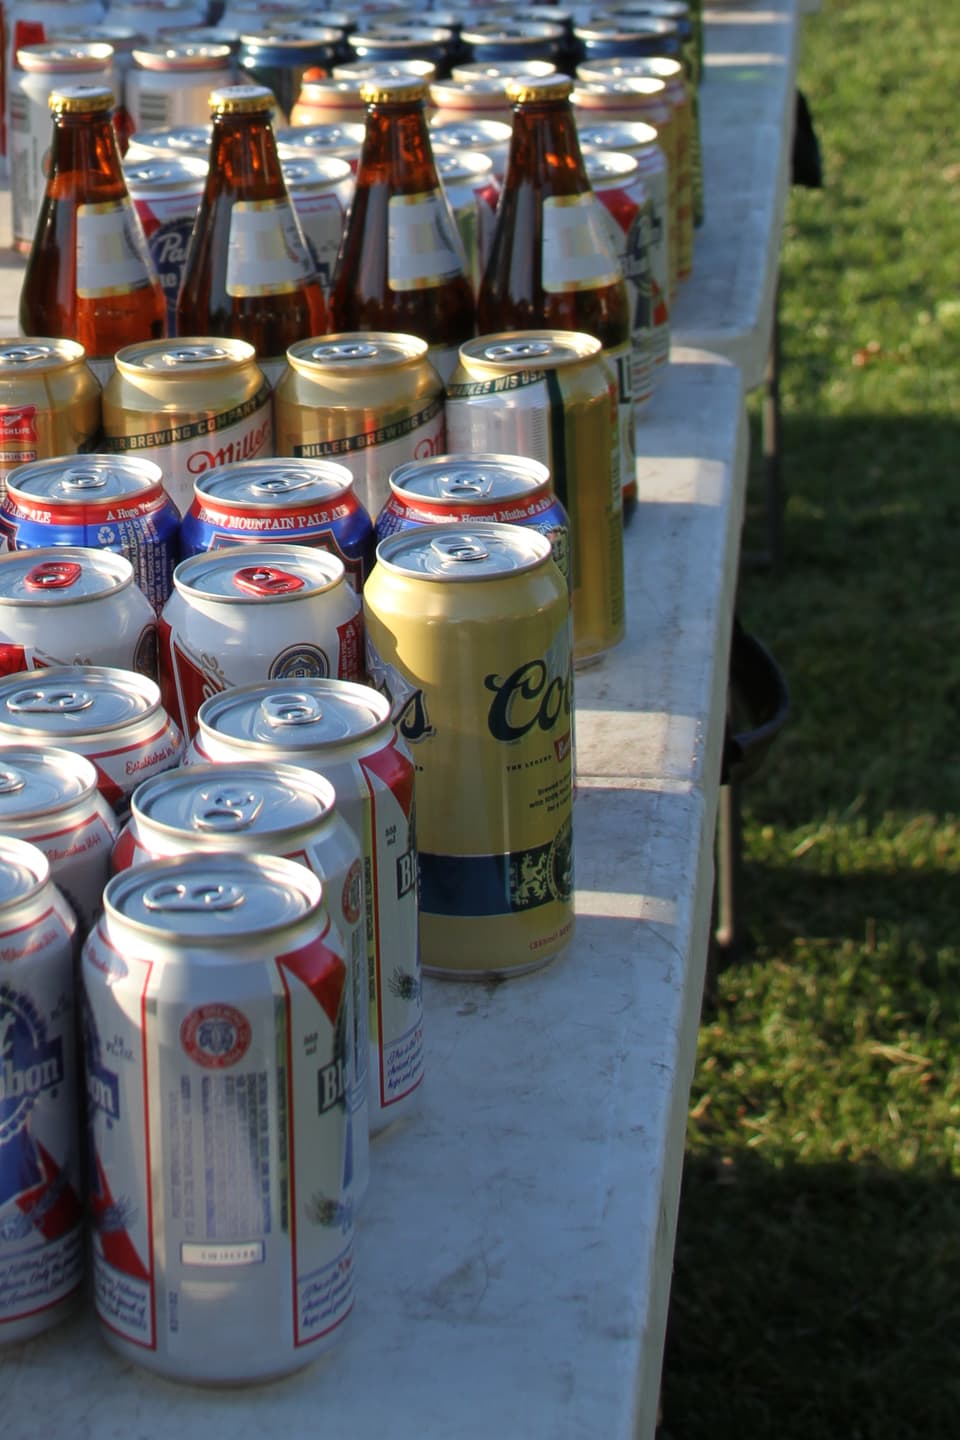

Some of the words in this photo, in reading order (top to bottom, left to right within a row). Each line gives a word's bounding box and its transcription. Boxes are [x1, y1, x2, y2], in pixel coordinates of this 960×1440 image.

[495, 375, 518, 391] WIS
[522, 369, 545, 384] USA
[130, 428, 191, 448] BREWING
[197, 401, 256, 434] COMPANY
[187, 420, 270, 474] Miller
[302, 439, 350, 457] MILLER
[357, 417, 419, 449] BREWING
[29, 510, 52, 523] ALE
[106, 512, 116, 521] A
[118, 508, 139, 519] Huge
[228, 517, 295, 530] MOUNTAIN
[297, 513, 329, 529] PALE
